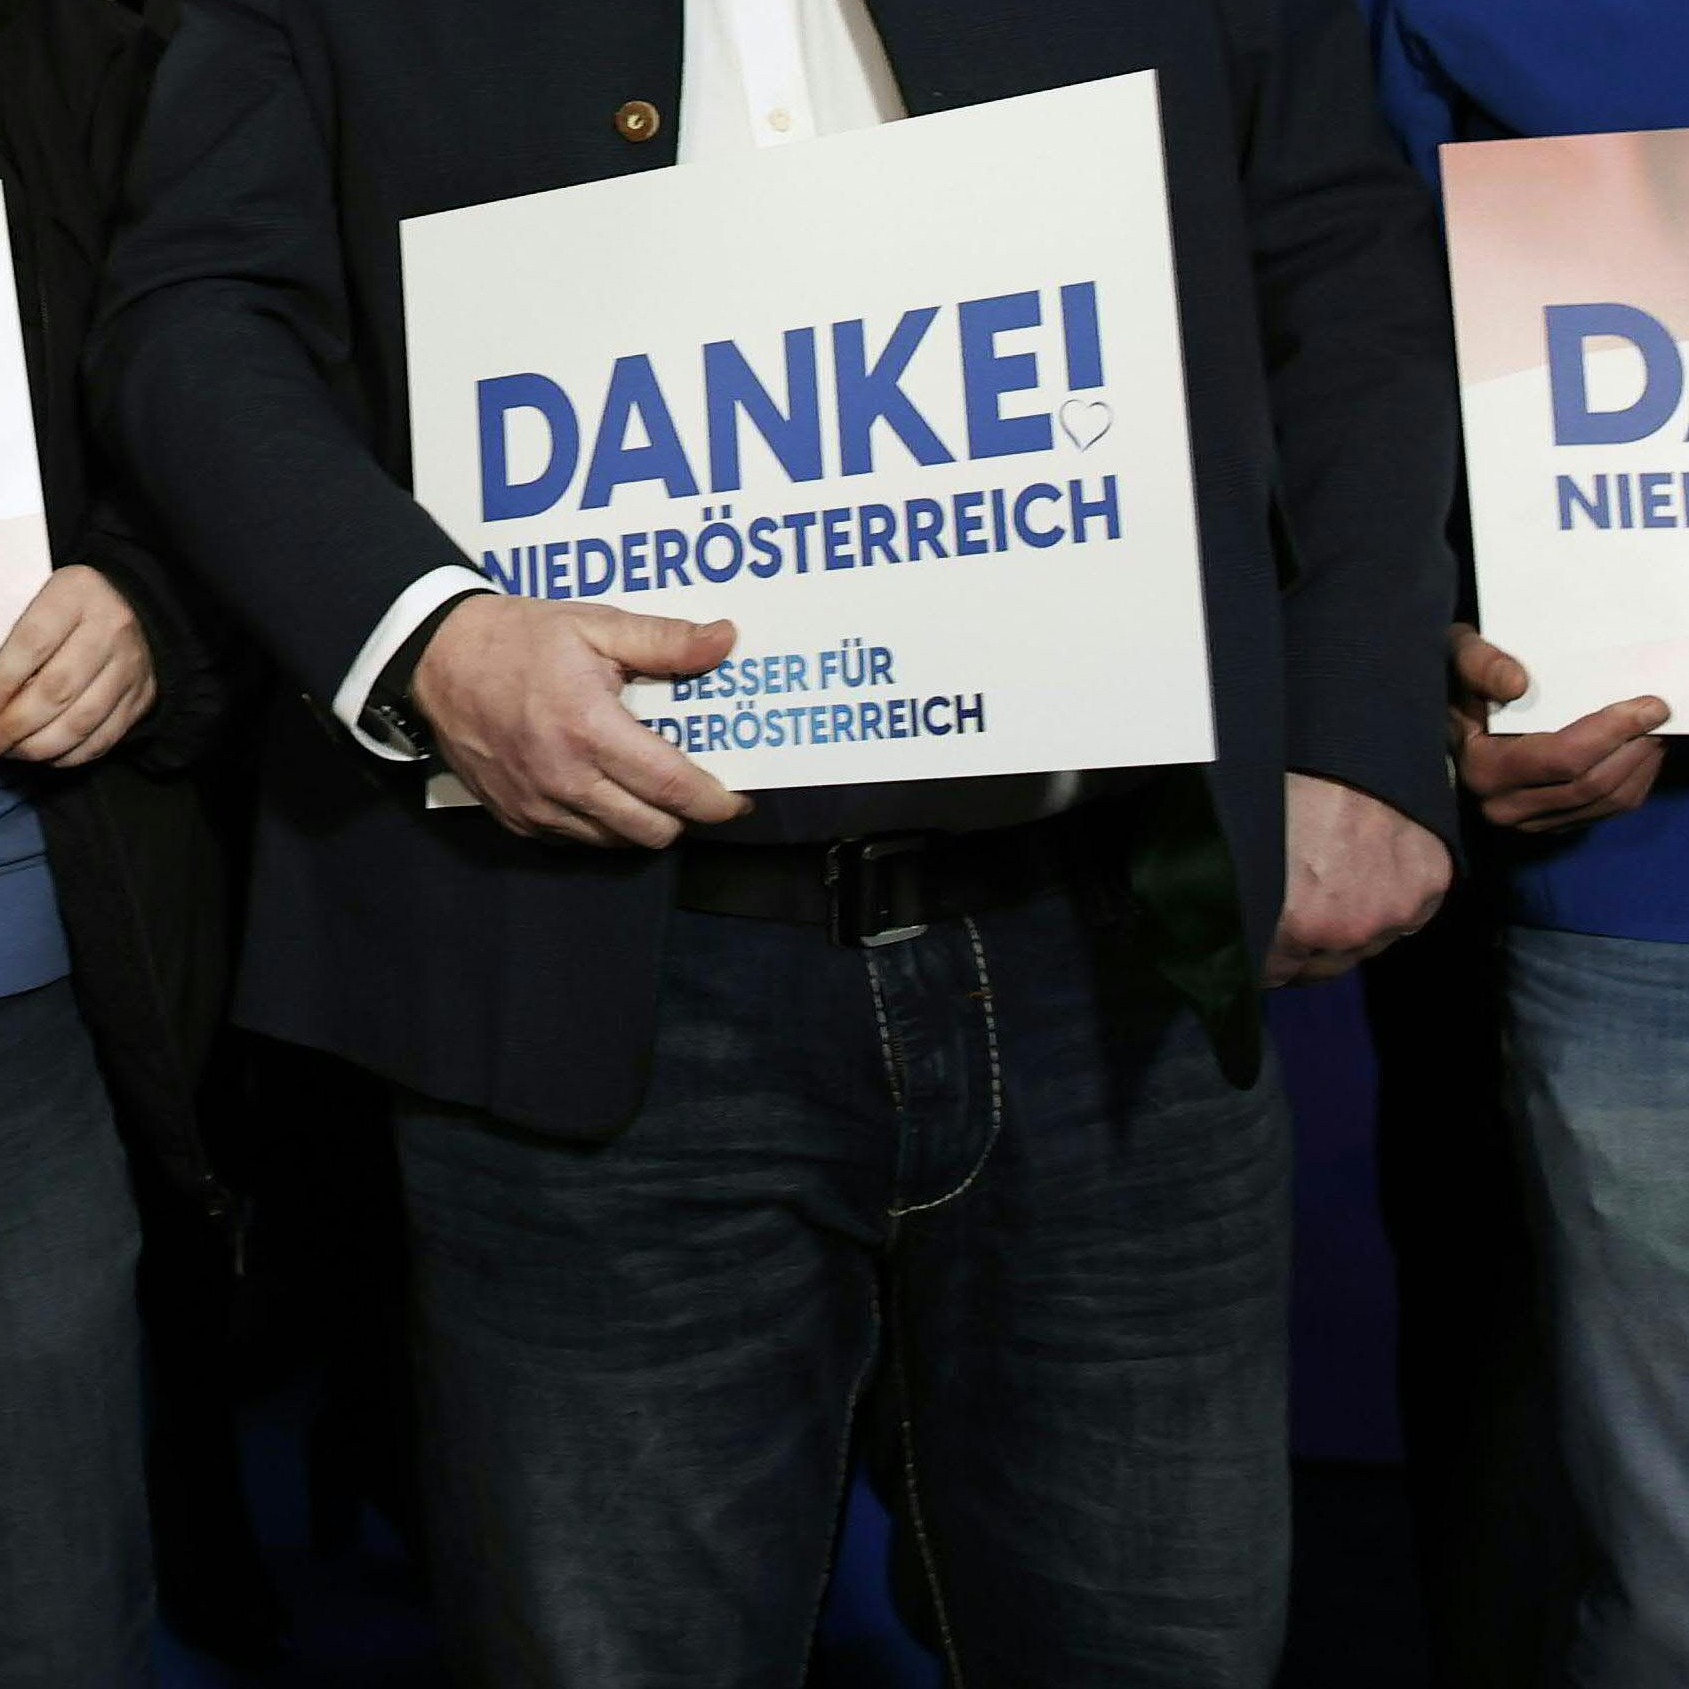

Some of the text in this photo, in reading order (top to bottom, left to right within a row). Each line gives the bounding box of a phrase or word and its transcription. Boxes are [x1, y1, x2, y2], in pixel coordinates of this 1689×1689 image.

[475, 279, 1113, 525] DANKE!
[481, 474, 1123, 602] NIEDERÖSTERREICH
[820, 638, 896, 688] FÜR
[637, 693, 986, 754] DERÖSTERREICH
